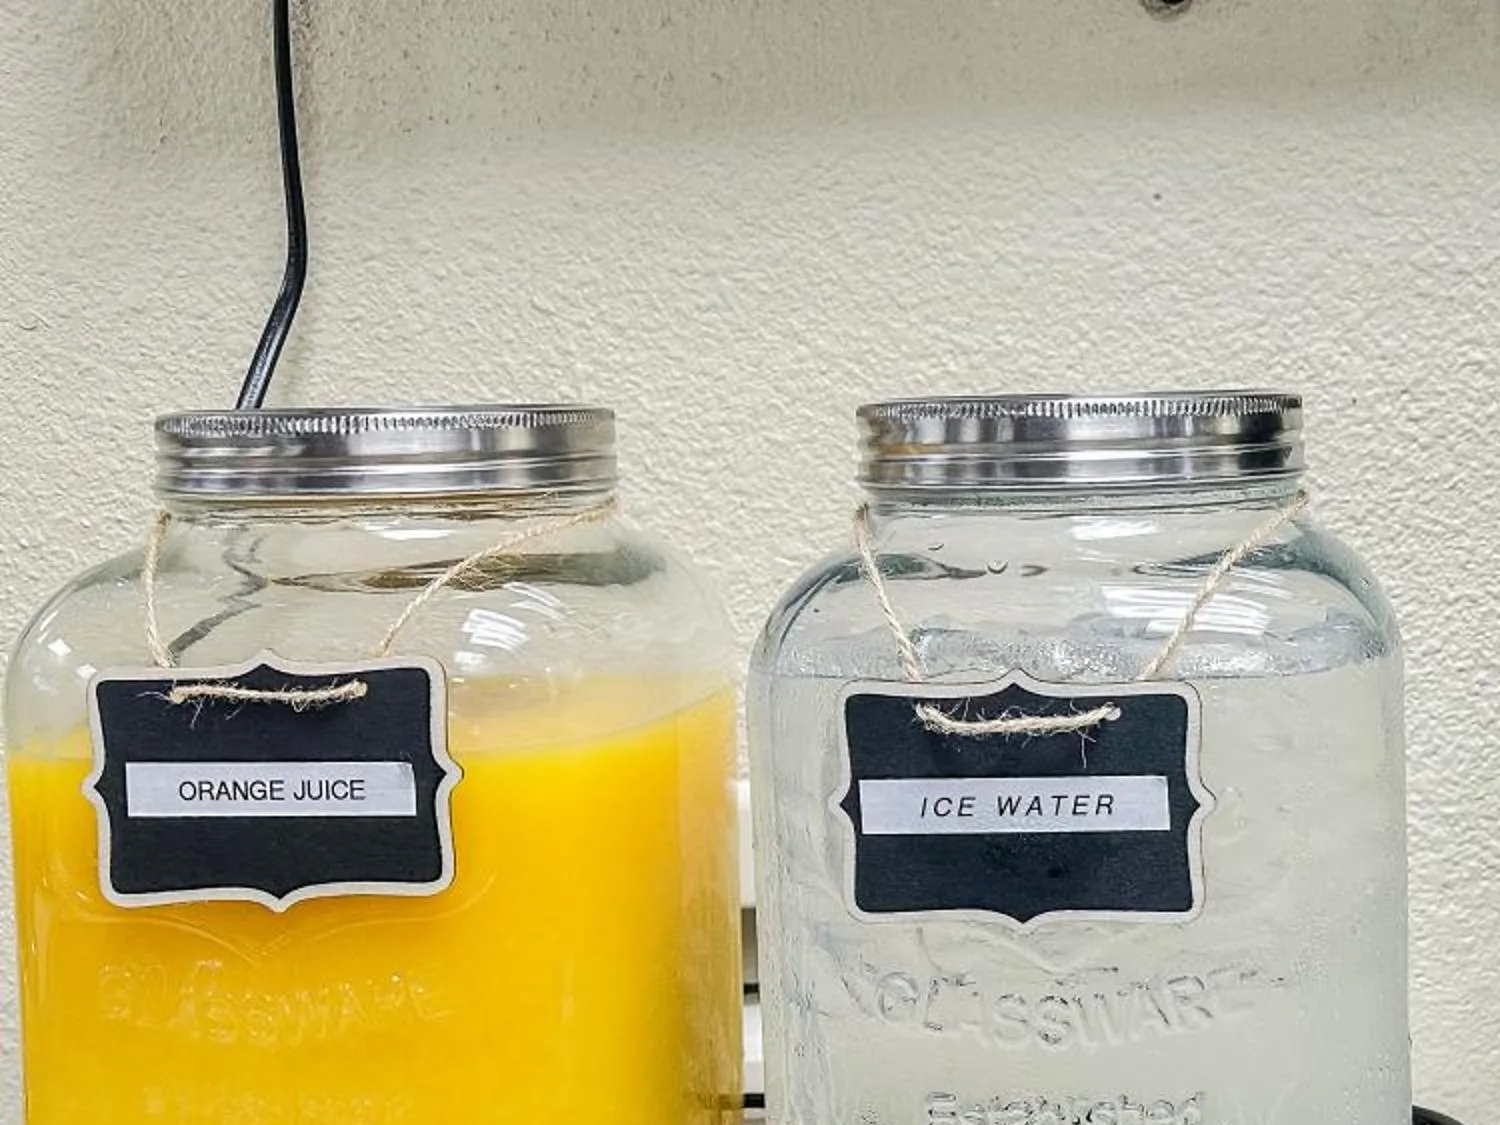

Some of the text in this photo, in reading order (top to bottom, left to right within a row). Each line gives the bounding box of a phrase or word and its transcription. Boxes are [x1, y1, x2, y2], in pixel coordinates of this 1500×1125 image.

[178, 779, 366, 801] ORANGE JUICE
[920, 794, 1116, 818] ICE WATER
